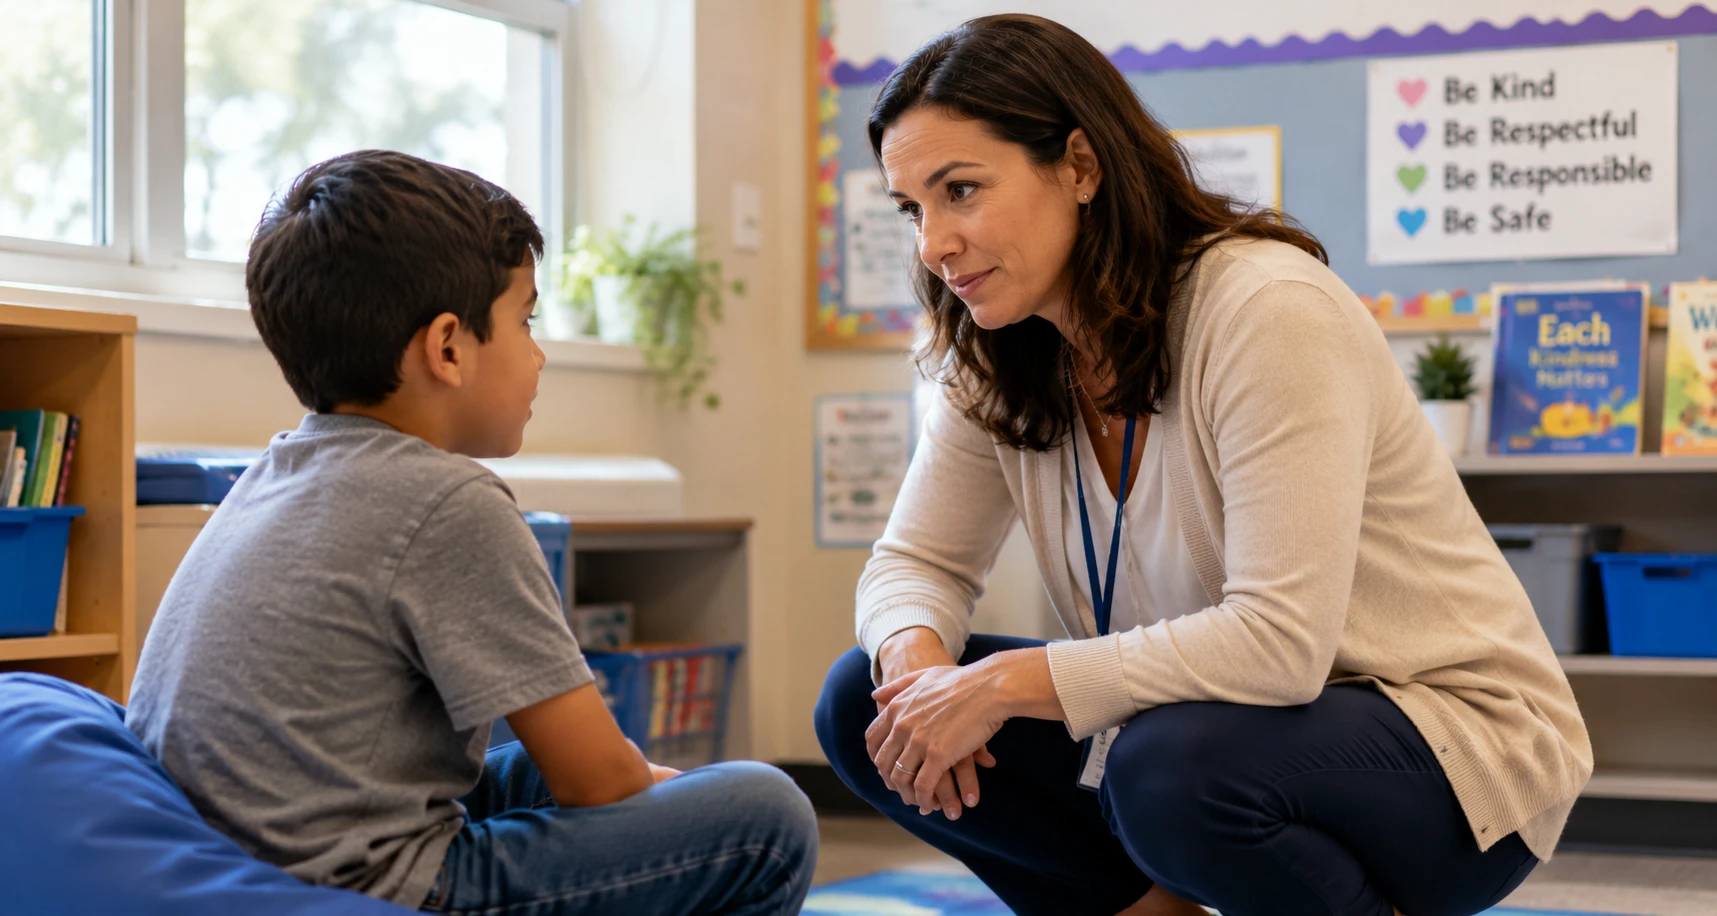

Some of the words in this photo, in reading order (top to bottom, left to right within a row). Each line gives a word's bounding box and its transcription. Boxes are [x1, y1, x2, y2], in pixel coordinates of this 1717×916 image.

[1444, 77, 1477, 104] Be
[1492, 70, 1556, 101] Kind
[1444, 120, 1476, 147] Be
[1491, 110, 1637, 150] Respectful
[1444, 163, 1476, 191] Be
[1490, 156, 1652, 194] Responsible
[1444, 207, 1476, 234] Be
[1491, 202, 1552, 233] Safe
[1539, 311, 1611, 347] Each
